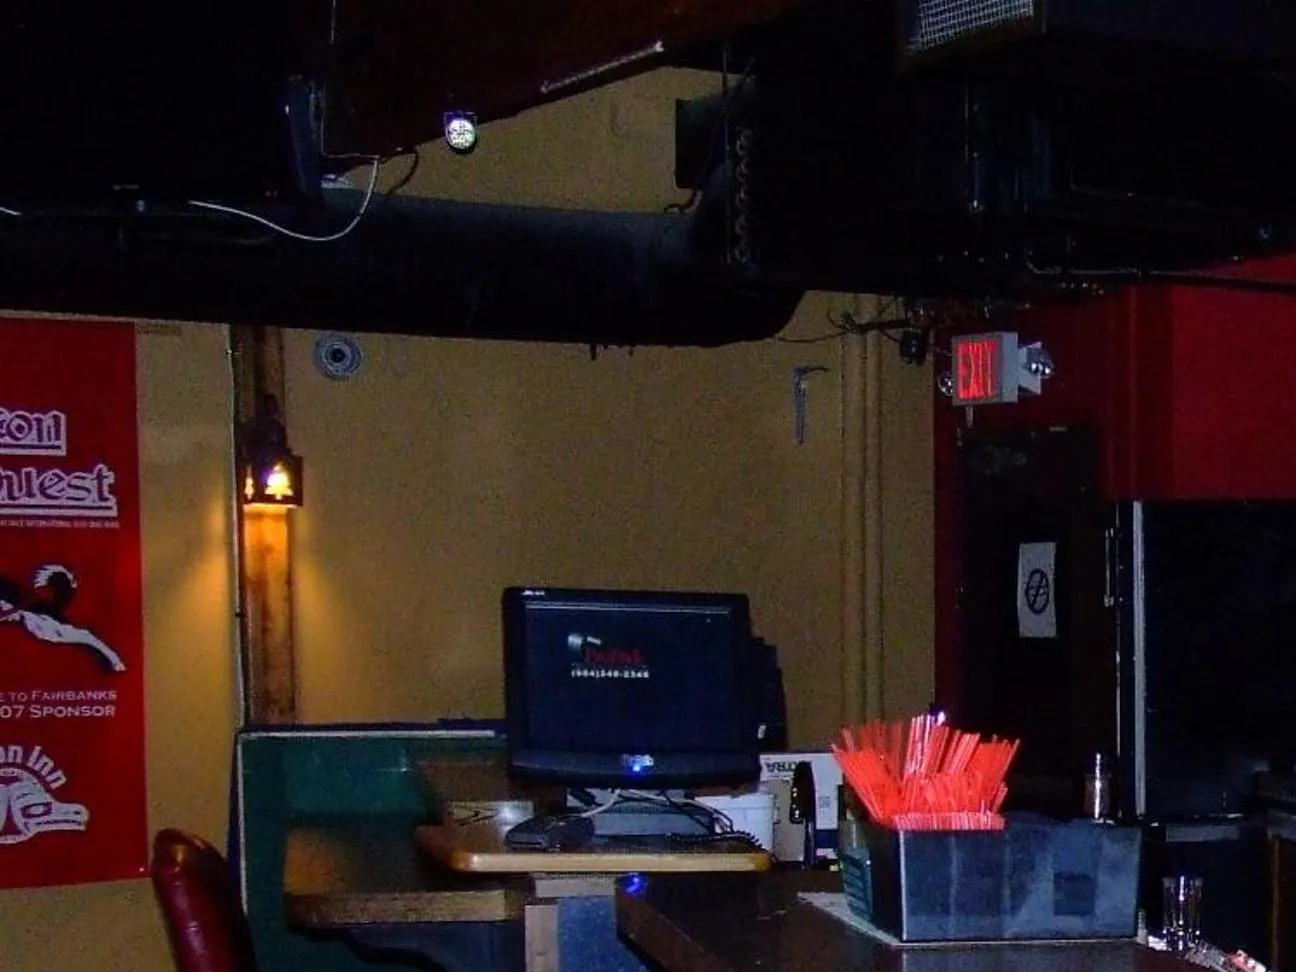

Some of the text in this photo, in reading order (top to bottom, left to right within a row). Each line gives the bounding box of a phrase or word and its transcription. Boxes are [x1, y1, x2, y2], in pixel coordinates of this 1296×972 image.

[958, 340, 997, 399] EXIT
[0, 409, 66, 449] on
[0, 464, 117, 506] uest
[10, 691, 28, 702] TO
[31, 690, 118, 701] FAIRBANKS
[29, 703, 117, 719] SPONSOR
[27, 744, 67, 790] Inn
